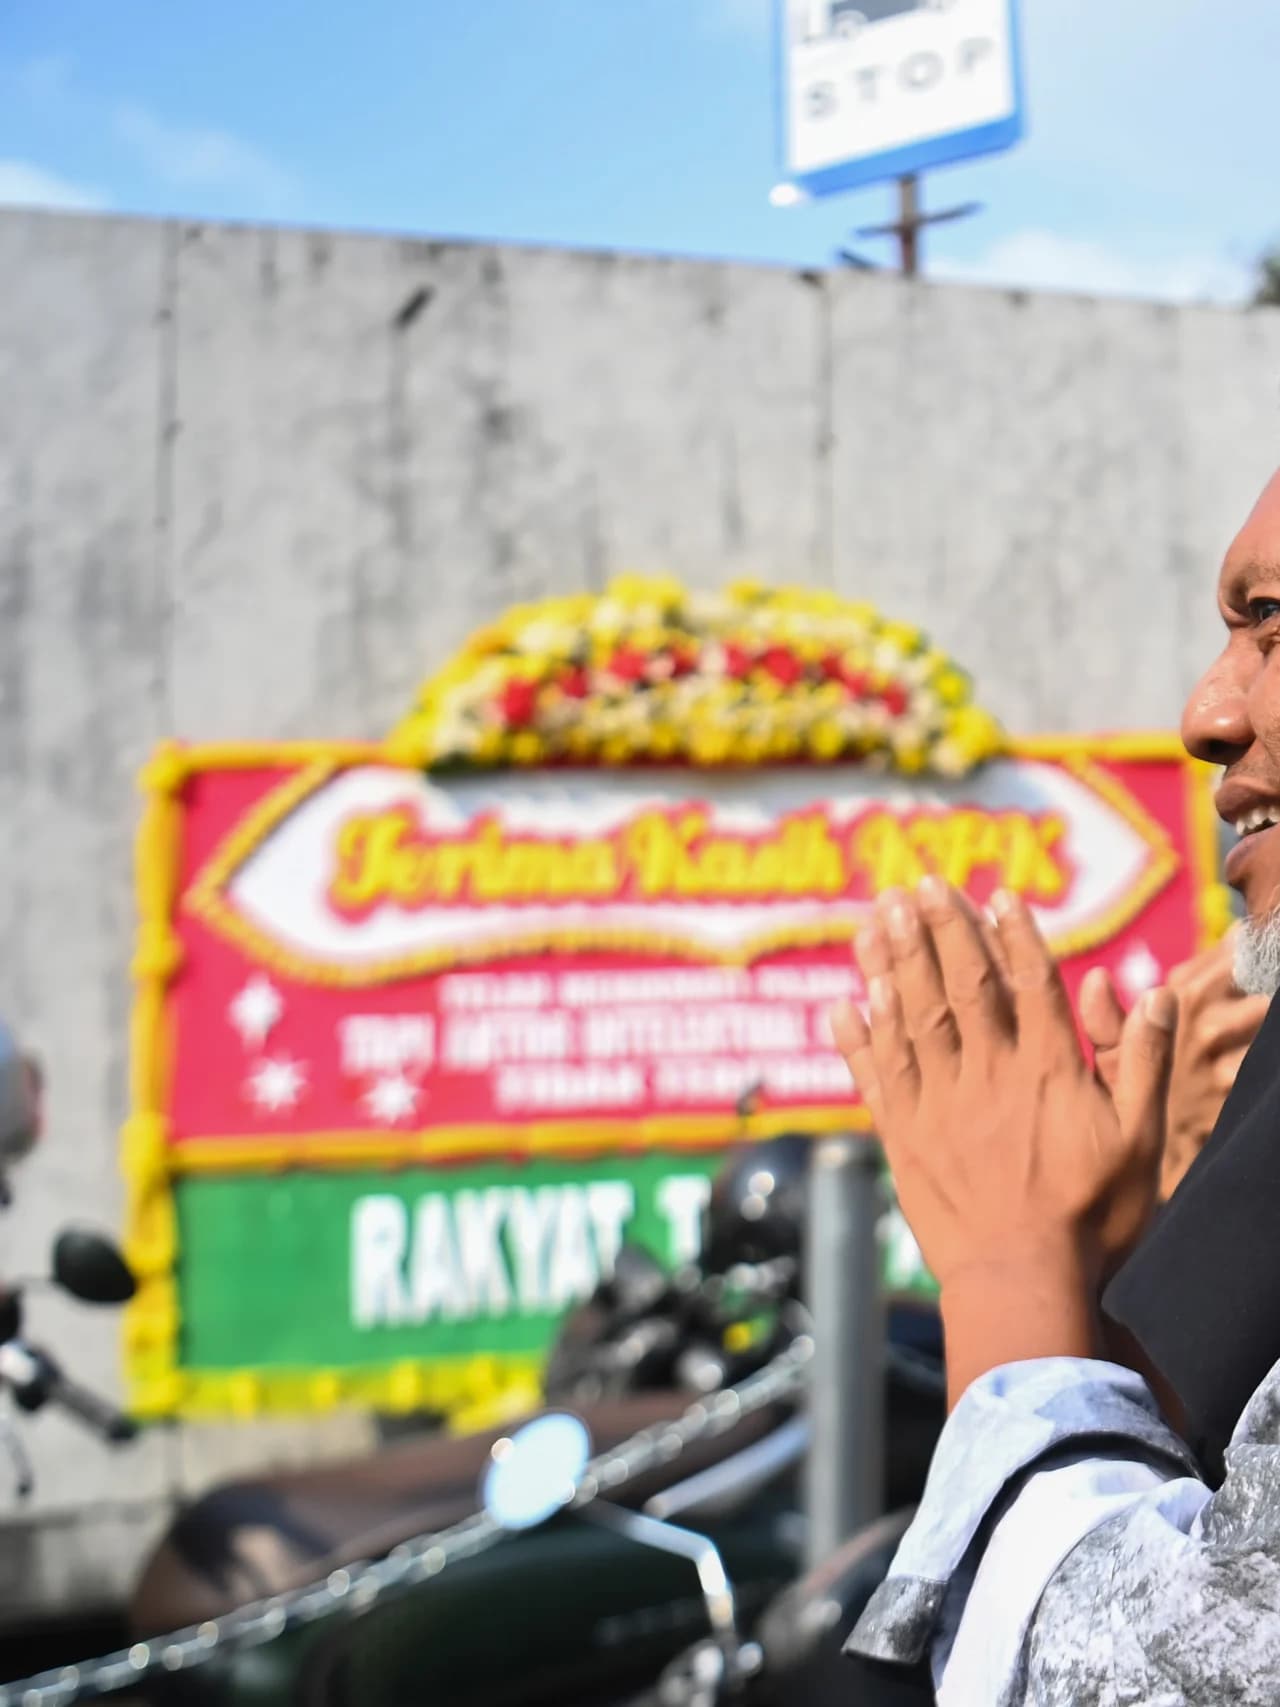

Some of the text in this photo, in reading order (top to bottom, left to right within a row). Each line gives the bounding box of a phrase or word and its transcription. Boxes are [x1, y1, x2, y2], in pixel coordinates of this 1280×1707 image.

[804, 36, 996, 122] STOP
[333, 806, 618, 906] Terima
[624, 808, 846, 896] Kasih
[350, 1179, 633, 1330] RAKYAT
